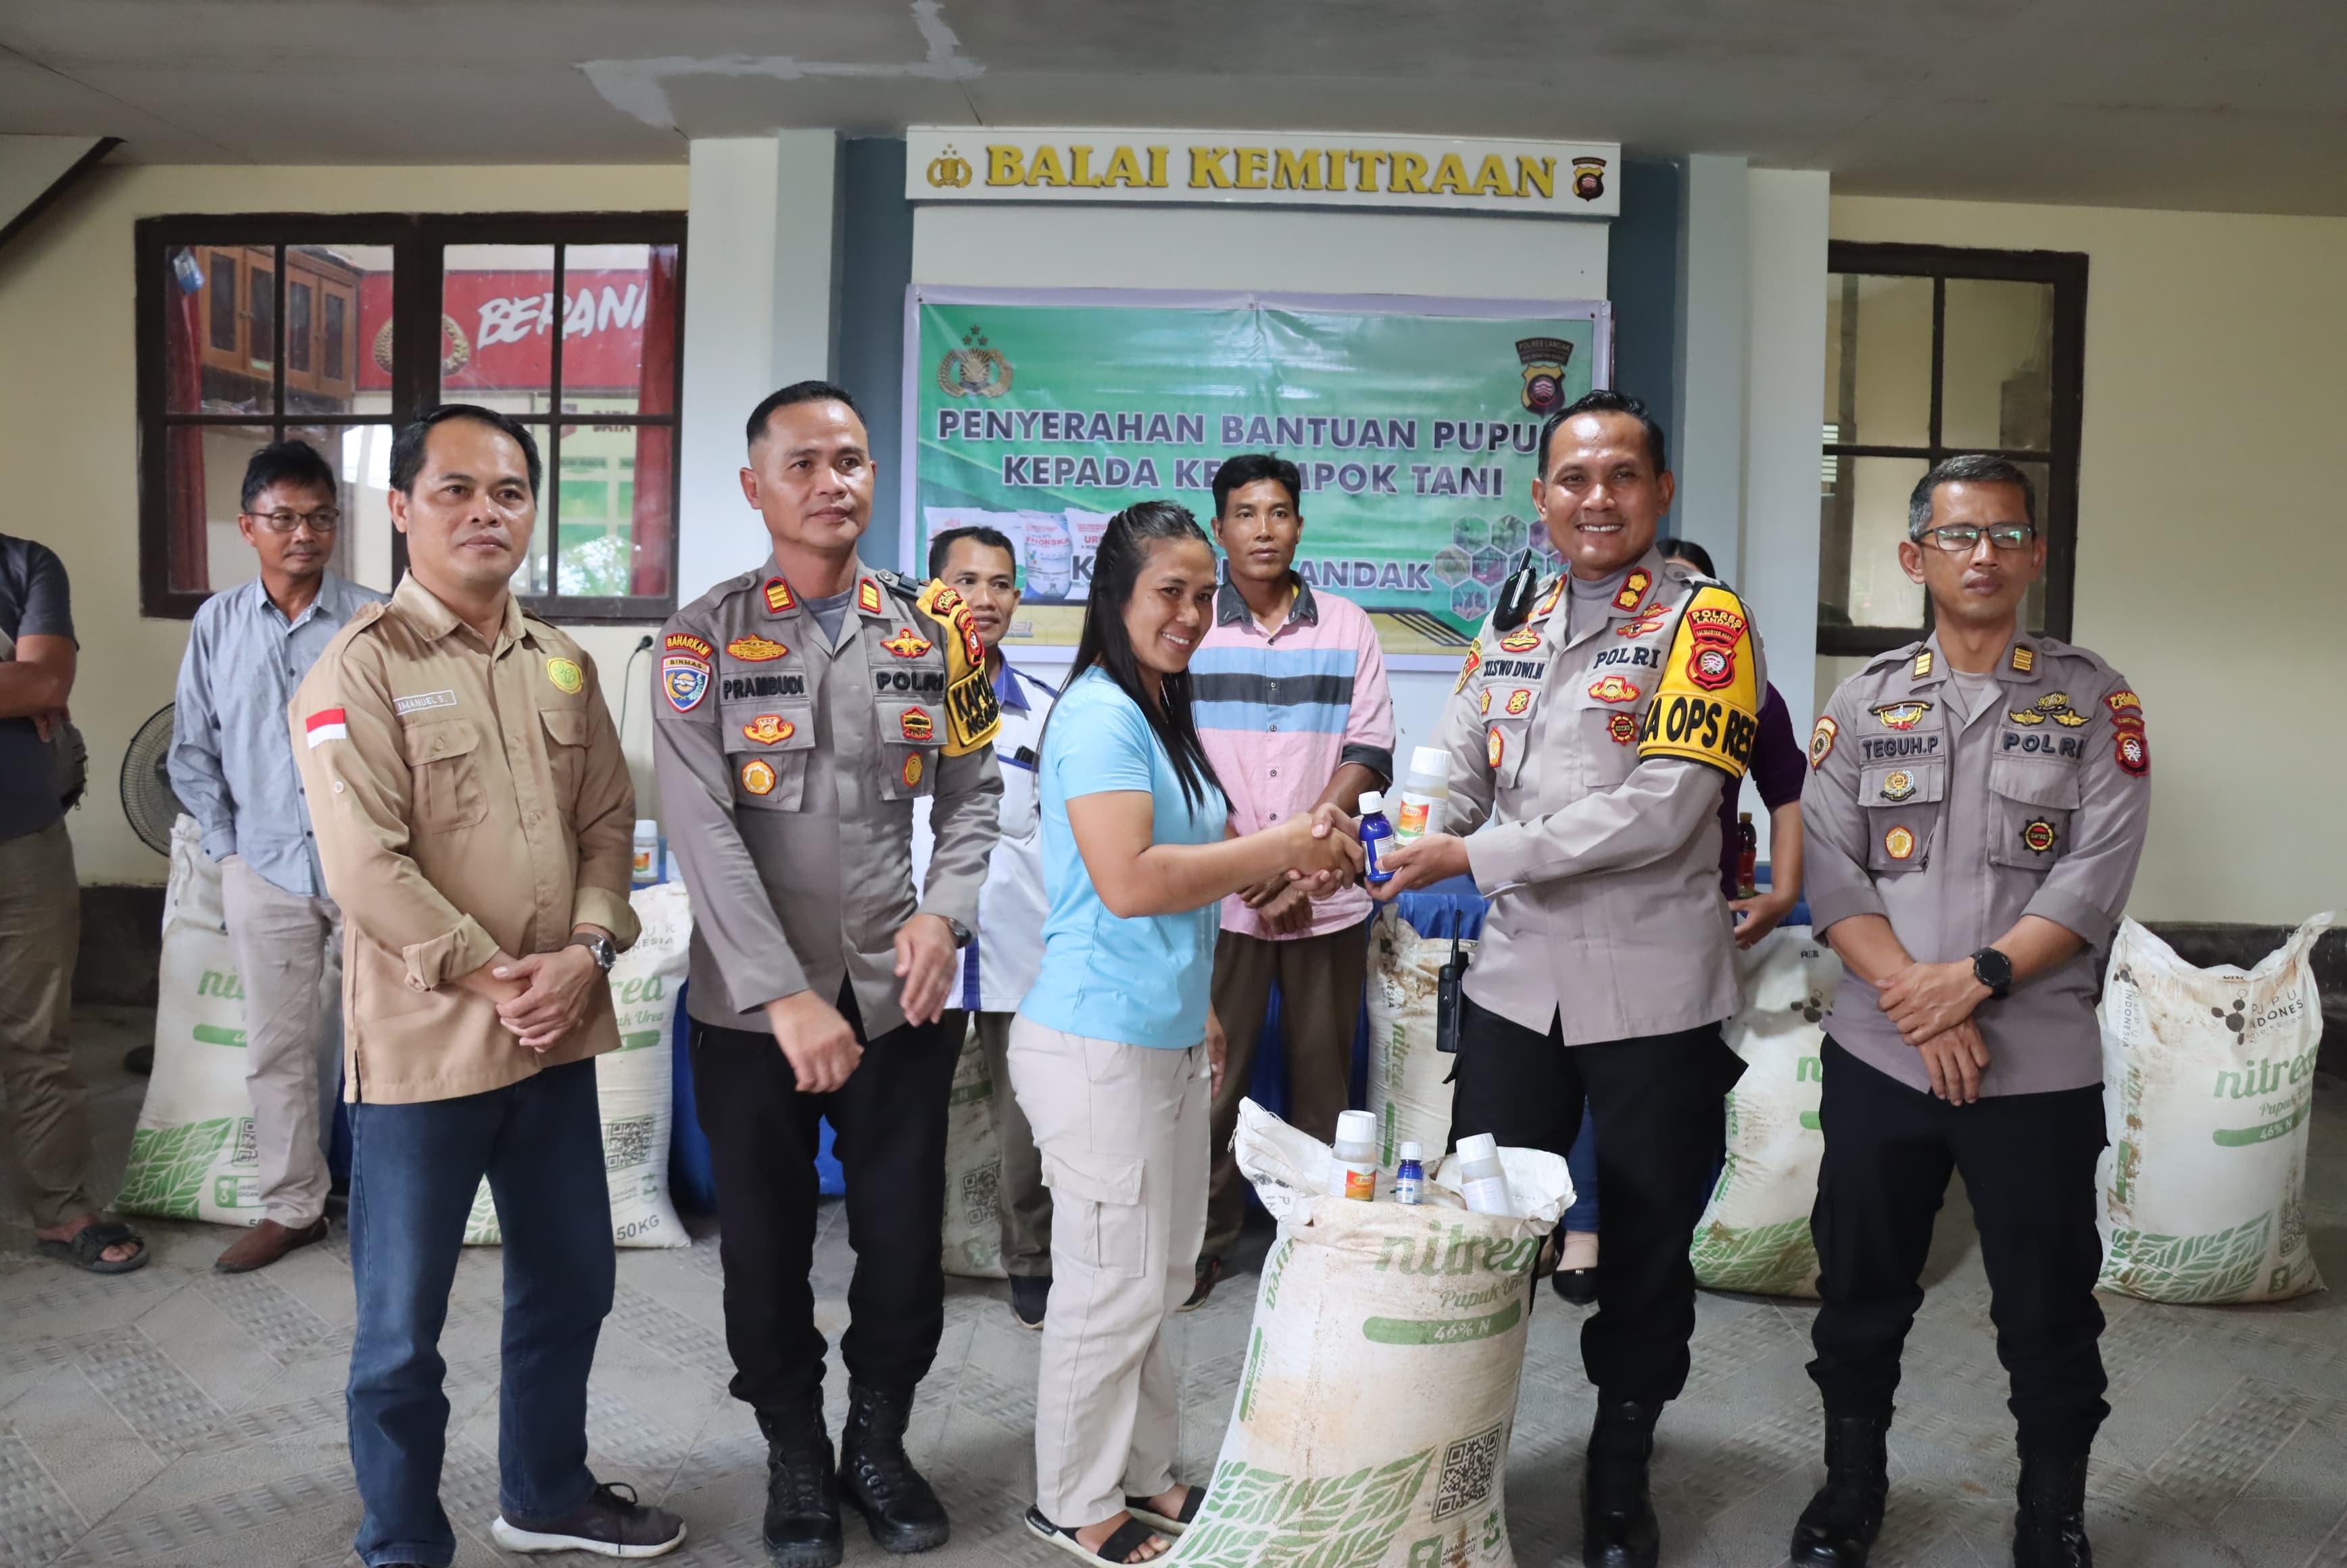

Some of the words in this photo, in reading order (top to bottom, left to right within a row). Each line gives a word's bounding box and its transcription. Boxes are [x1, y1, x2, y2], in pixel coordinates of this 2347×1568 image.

[985, 144, 1169, 189] BALAI
[1188, 147, 1556, 198] KEMITRAAN
[938, 408, 1205, 445] PENYERAHAN
[1221, 414, 1416, 449] BANTUAN
[1432, 420, 1539, 454] PUPU
[1002, 454, 1161, 489] KEPADA
[1174, 458, 1398, 494] KEPOK
[1411, 464, 1503, 497] TANI
[1296, 558, 1433, 591] ANDAK
[1691, 610, 1743, 629] POLRES
[1697, 617, 1737, 632] LANDAK
[667, 635, 710, 656] BAHARKAM
[1593, 646, 1662, 670] POLRI
[670, 658, 702, 669] BINMAS
[723, 675, 804, 700] PRAMBUDI
[876, 672, 944, 691] POLRI
[1666, 696, 1722, 748] OPS
[1862, 735, 1938, 760] TEGUH.P
[2003, 732, 2085, 759] POLRI
[2260, 1124, 2283, 1140] 46%
[1439, 1283, 1500, 1311] Pupuk
[1433, 1321, 1474, 1342] 46%
[1478, 1318, 1492, 1335] N
[1257, 1340, 1269, 1386] PUPUK
[1248, 1388, 1259, 1422] UREA
